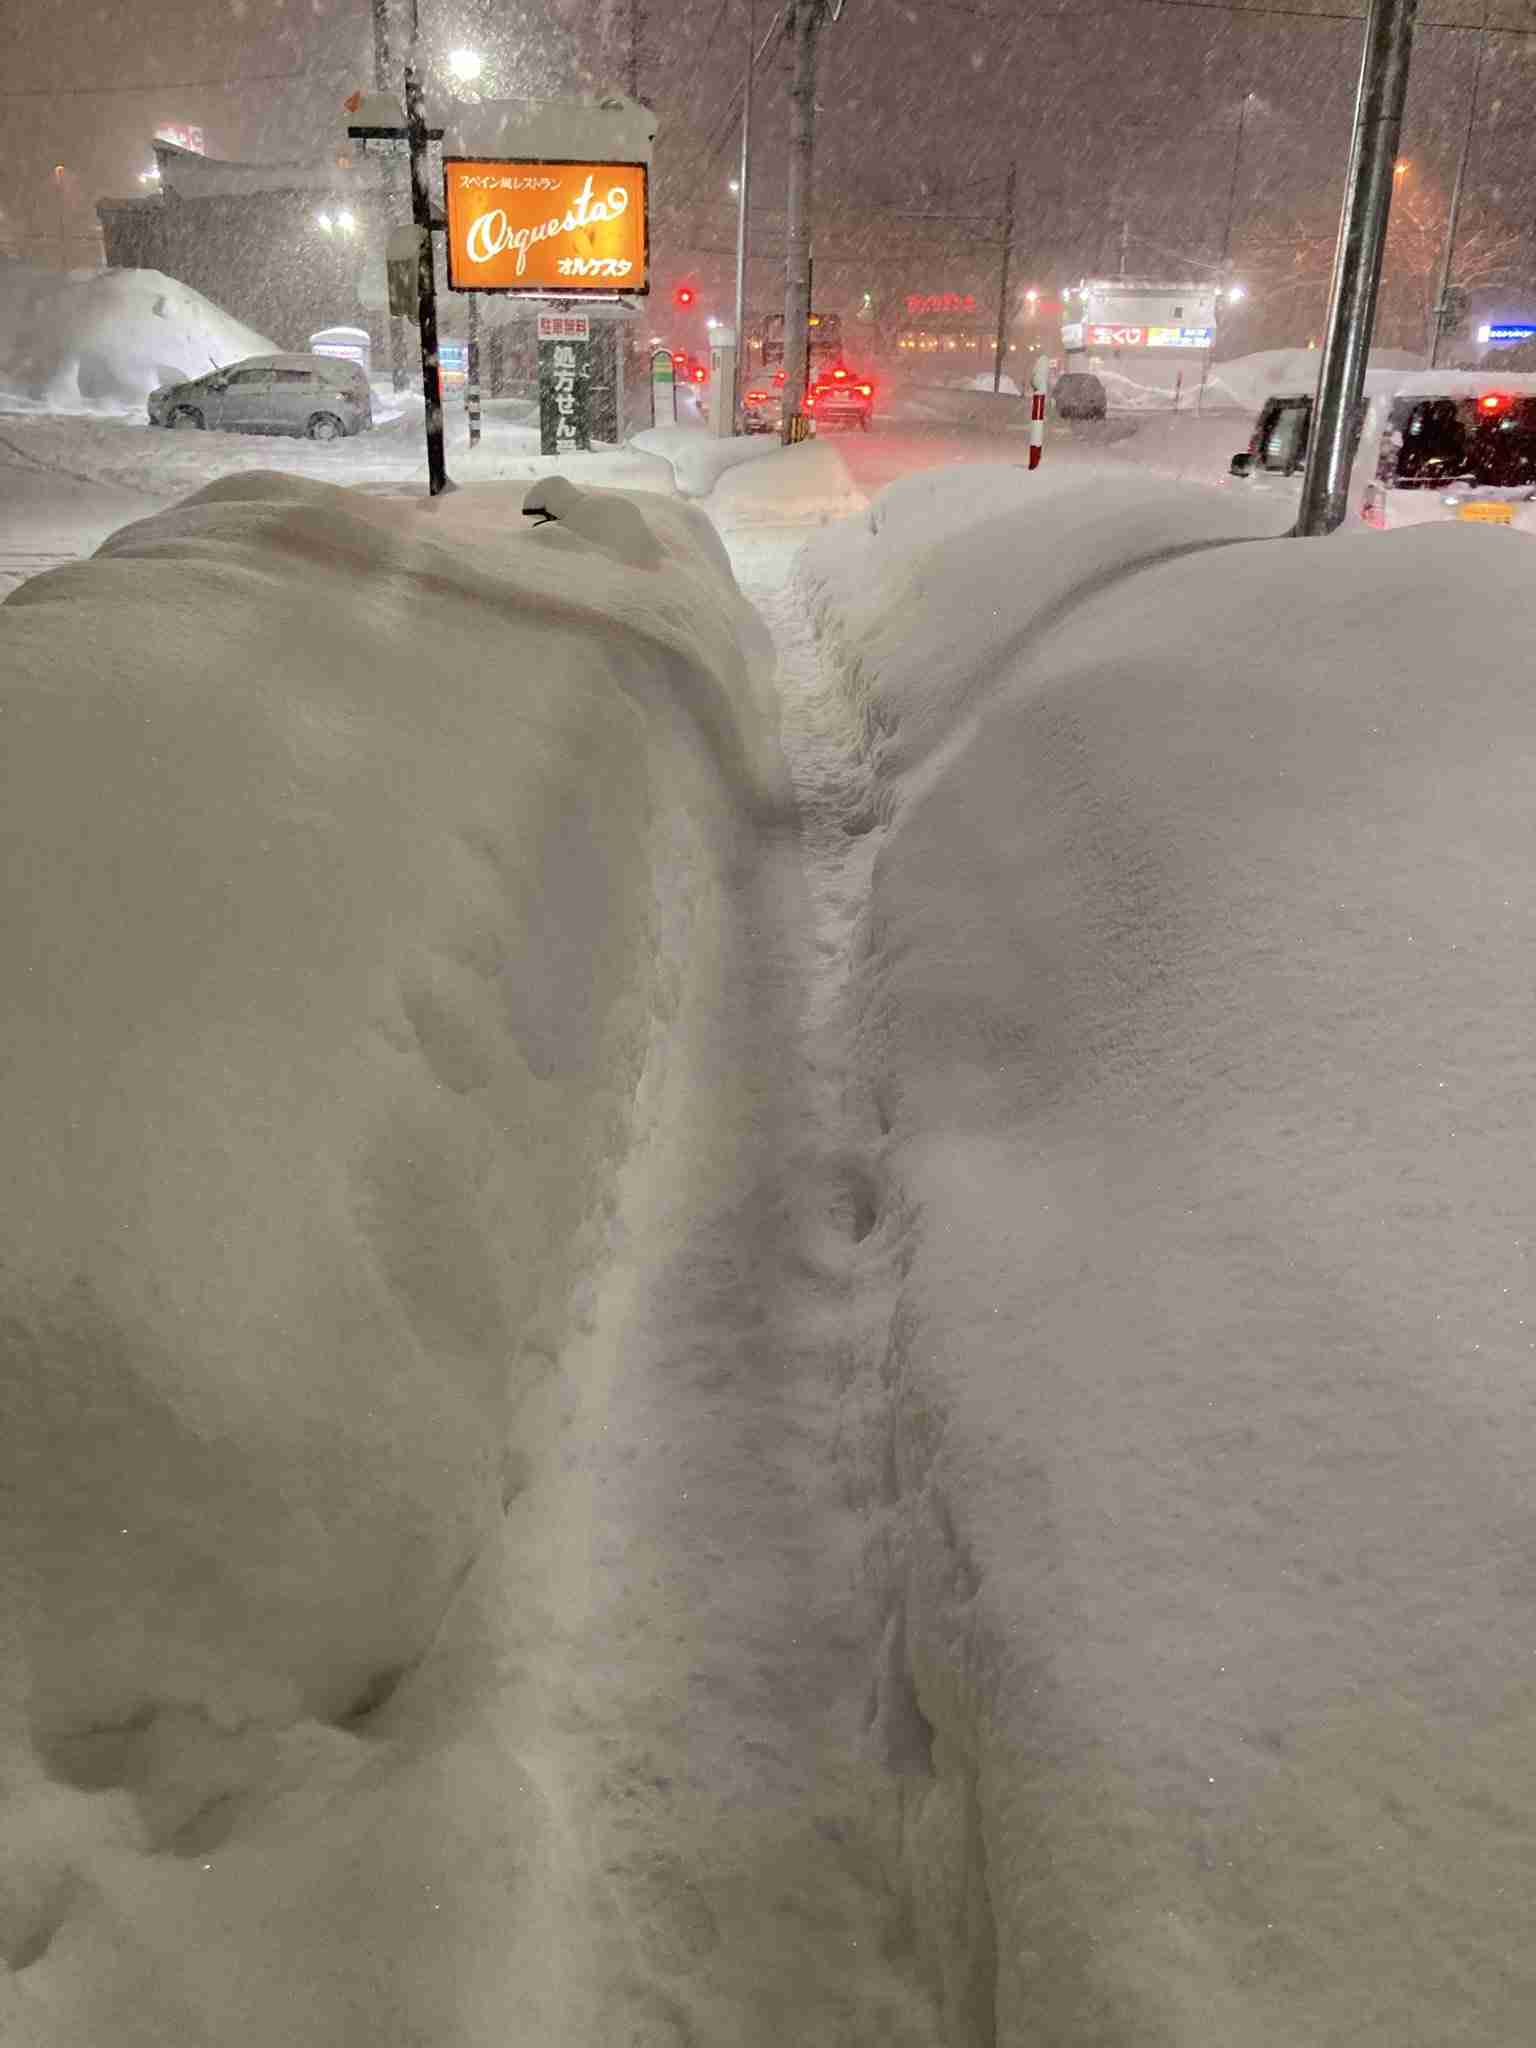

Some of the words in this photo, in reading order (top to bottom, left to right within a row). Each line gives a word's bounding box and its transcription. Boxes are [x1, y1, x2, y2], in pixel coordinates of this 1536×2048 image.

[459, 175, 562, 190] スペイン風レストラン
[466, 175, 629, 276] Orquesta
[557, 257, 633, 277] オルケスタ
